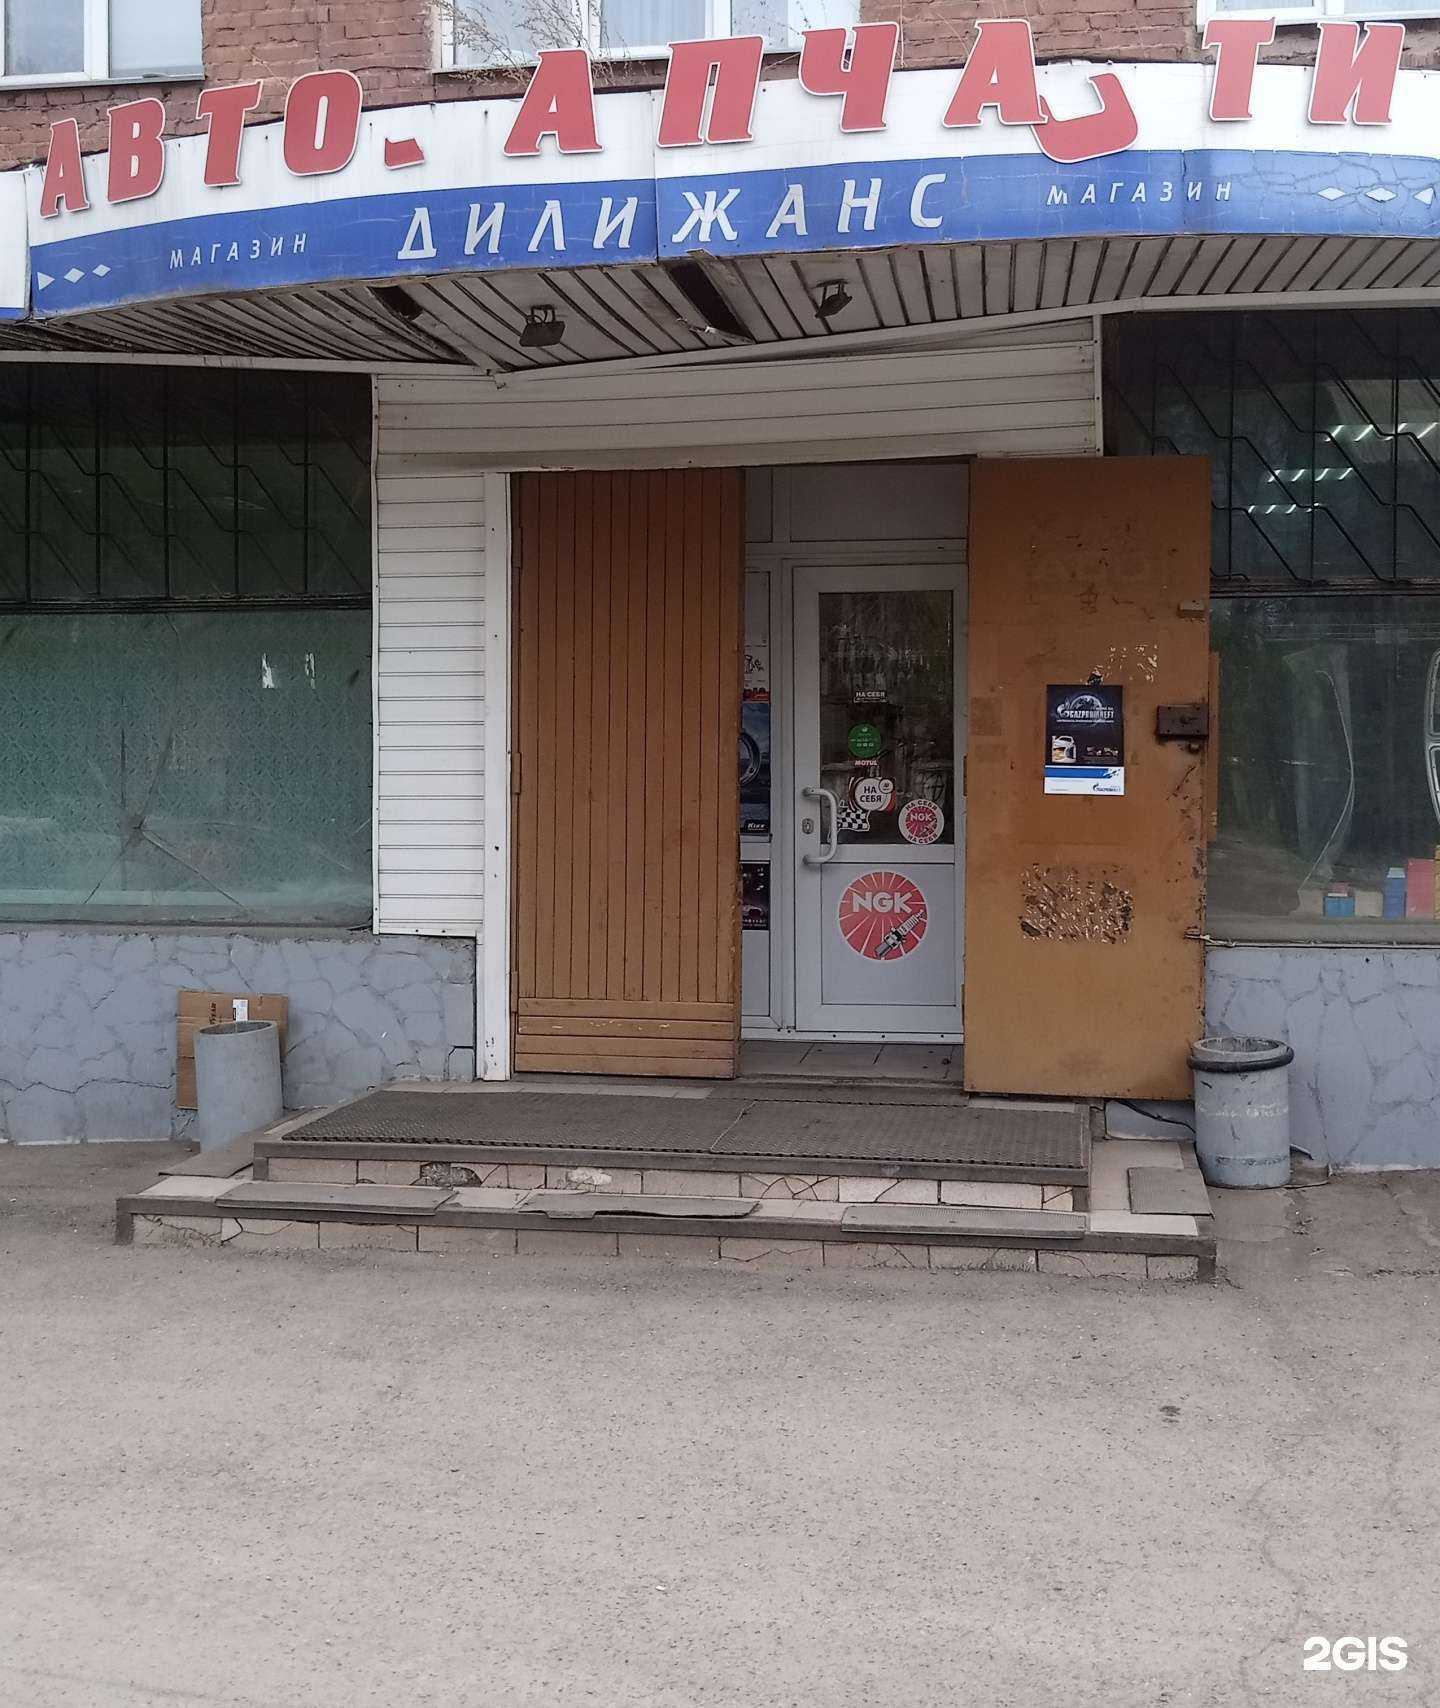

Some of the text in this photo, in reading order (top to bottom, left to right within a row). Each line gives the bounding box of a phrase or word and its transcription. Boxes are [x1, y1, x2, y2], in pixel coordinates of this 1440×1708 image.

[1046, 181, 1233, 206] МАГАЗИН
[397, 173, 947, 260] ДИЛИЖАНС
[169, 233, 307, 269] МАГАЗИН
[859, 795, 882, 803] СЕБЯ
[863, 786, 877, 794] НА
[910, 813, 933, 822] NGK
[852, 891, 913, 914] NGK
